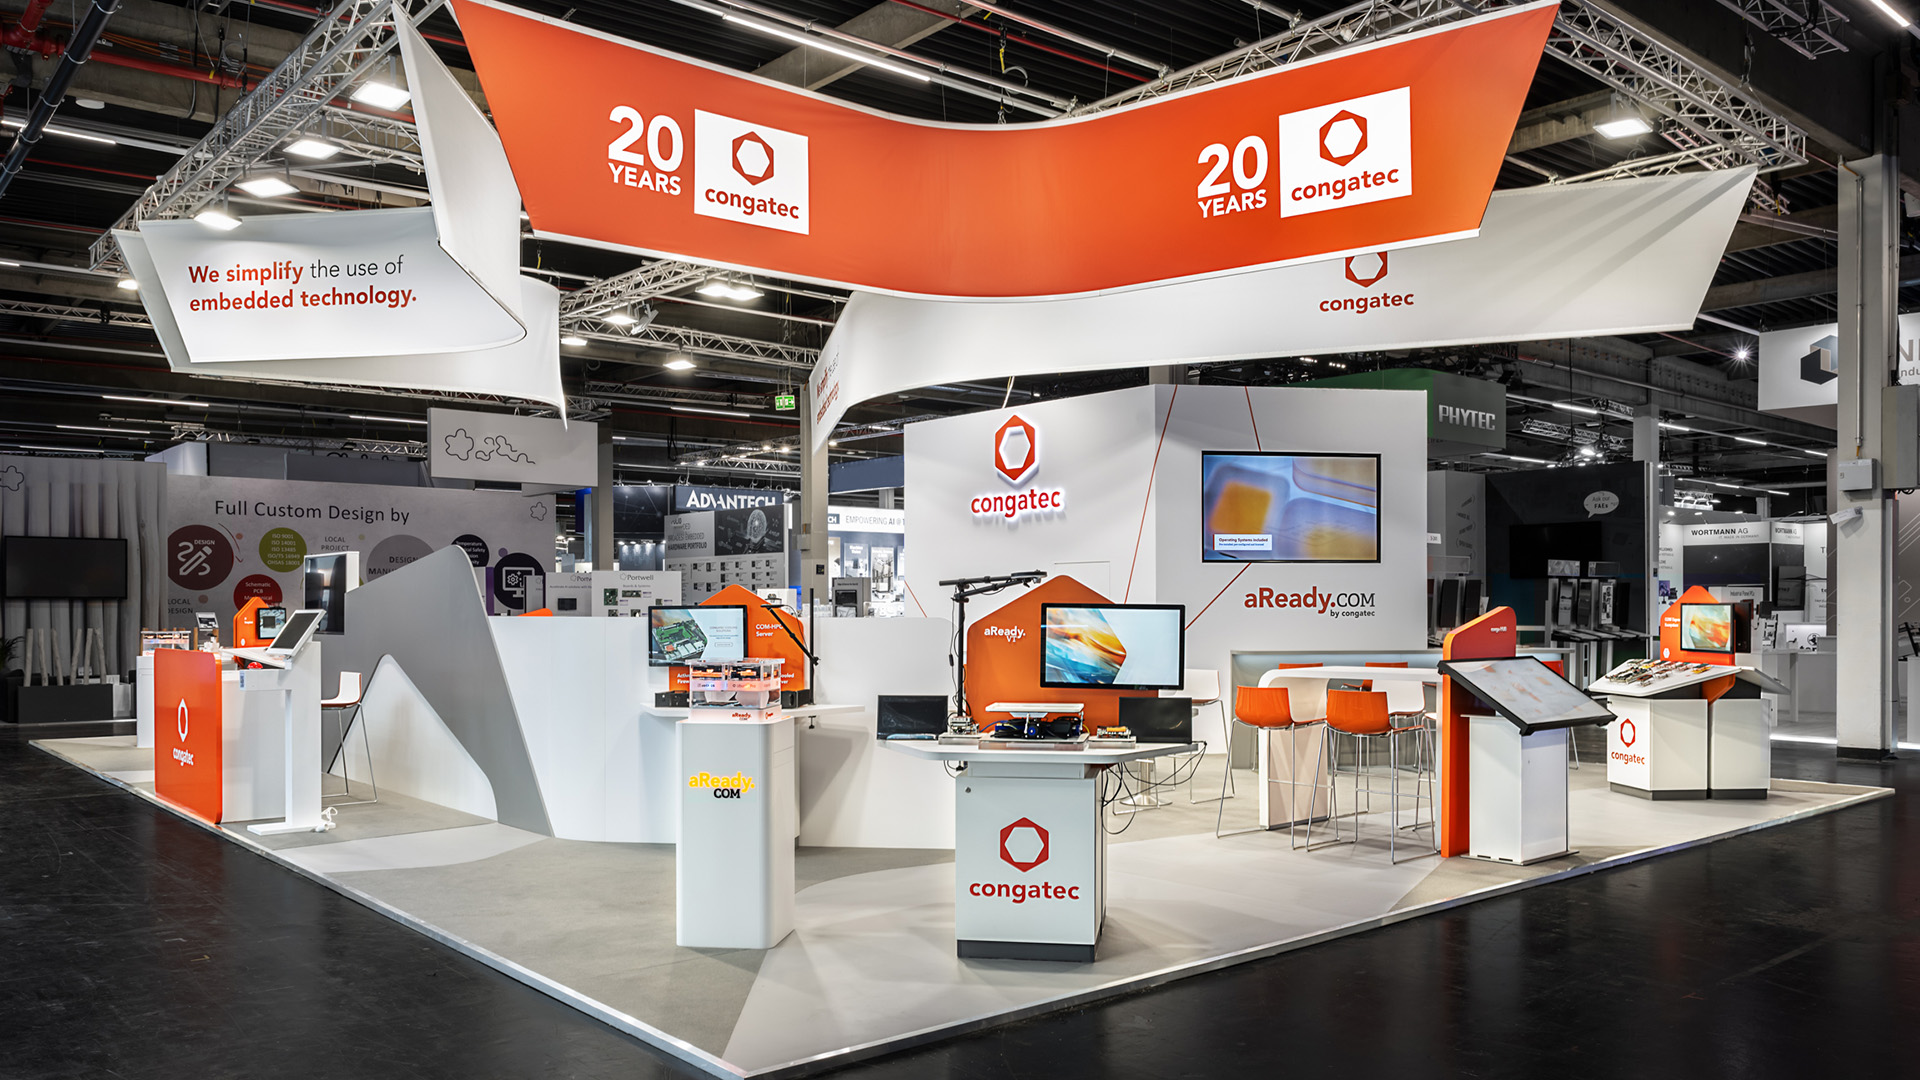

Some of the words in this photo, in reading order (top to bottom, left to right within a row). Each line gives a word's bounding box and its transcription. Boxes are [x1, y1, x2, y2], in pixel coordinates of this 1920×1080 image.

[608, 106, 683, 173] 20
[608, 162, 682, 195] YEARS
[1198, 136, 1268, 200] 20
[1291, 168, 1399, 201] congatec
[704, 189, 799, 220] congatec
[1198, 188, 1266, 218] YEARS
[189, 266, 219, 283] We
[227, 261, 303, 285] simplify
[310, 260, 339, 278] the
[347, 263, 378, 276] use
[385, 255, 403, 274] of
[190, 289, 293, 311] embedded
[300, 285, 416, 308] technology.
[1320, 293, 1414, 314] congatec
[1439, 405, 1495, 429] PHYTEC
[686, 489, 776, 509] ADVANTECH
[972, 489, 1060, 517] congatec
[215, 500, 247, 515] Full
[254, 502, 322, 519] Custom
[328, 505, 384, 524] Design
[390, 507, 410, 525] by
[845, 515, 887, 524] EMPOWERING
[1330, 610, 1340, 618] by
[1342, 610, 1375, 618] congatec
[984, 626, 1026, 639] aReady.
[173, 748, 193, 766] congatec
[1611, 751, 1645, 764] congatec
[688, 771, 755, 793] aReady.
[714, 788, 740, 798] COM
[970, 882, 1079, 903] congatec
